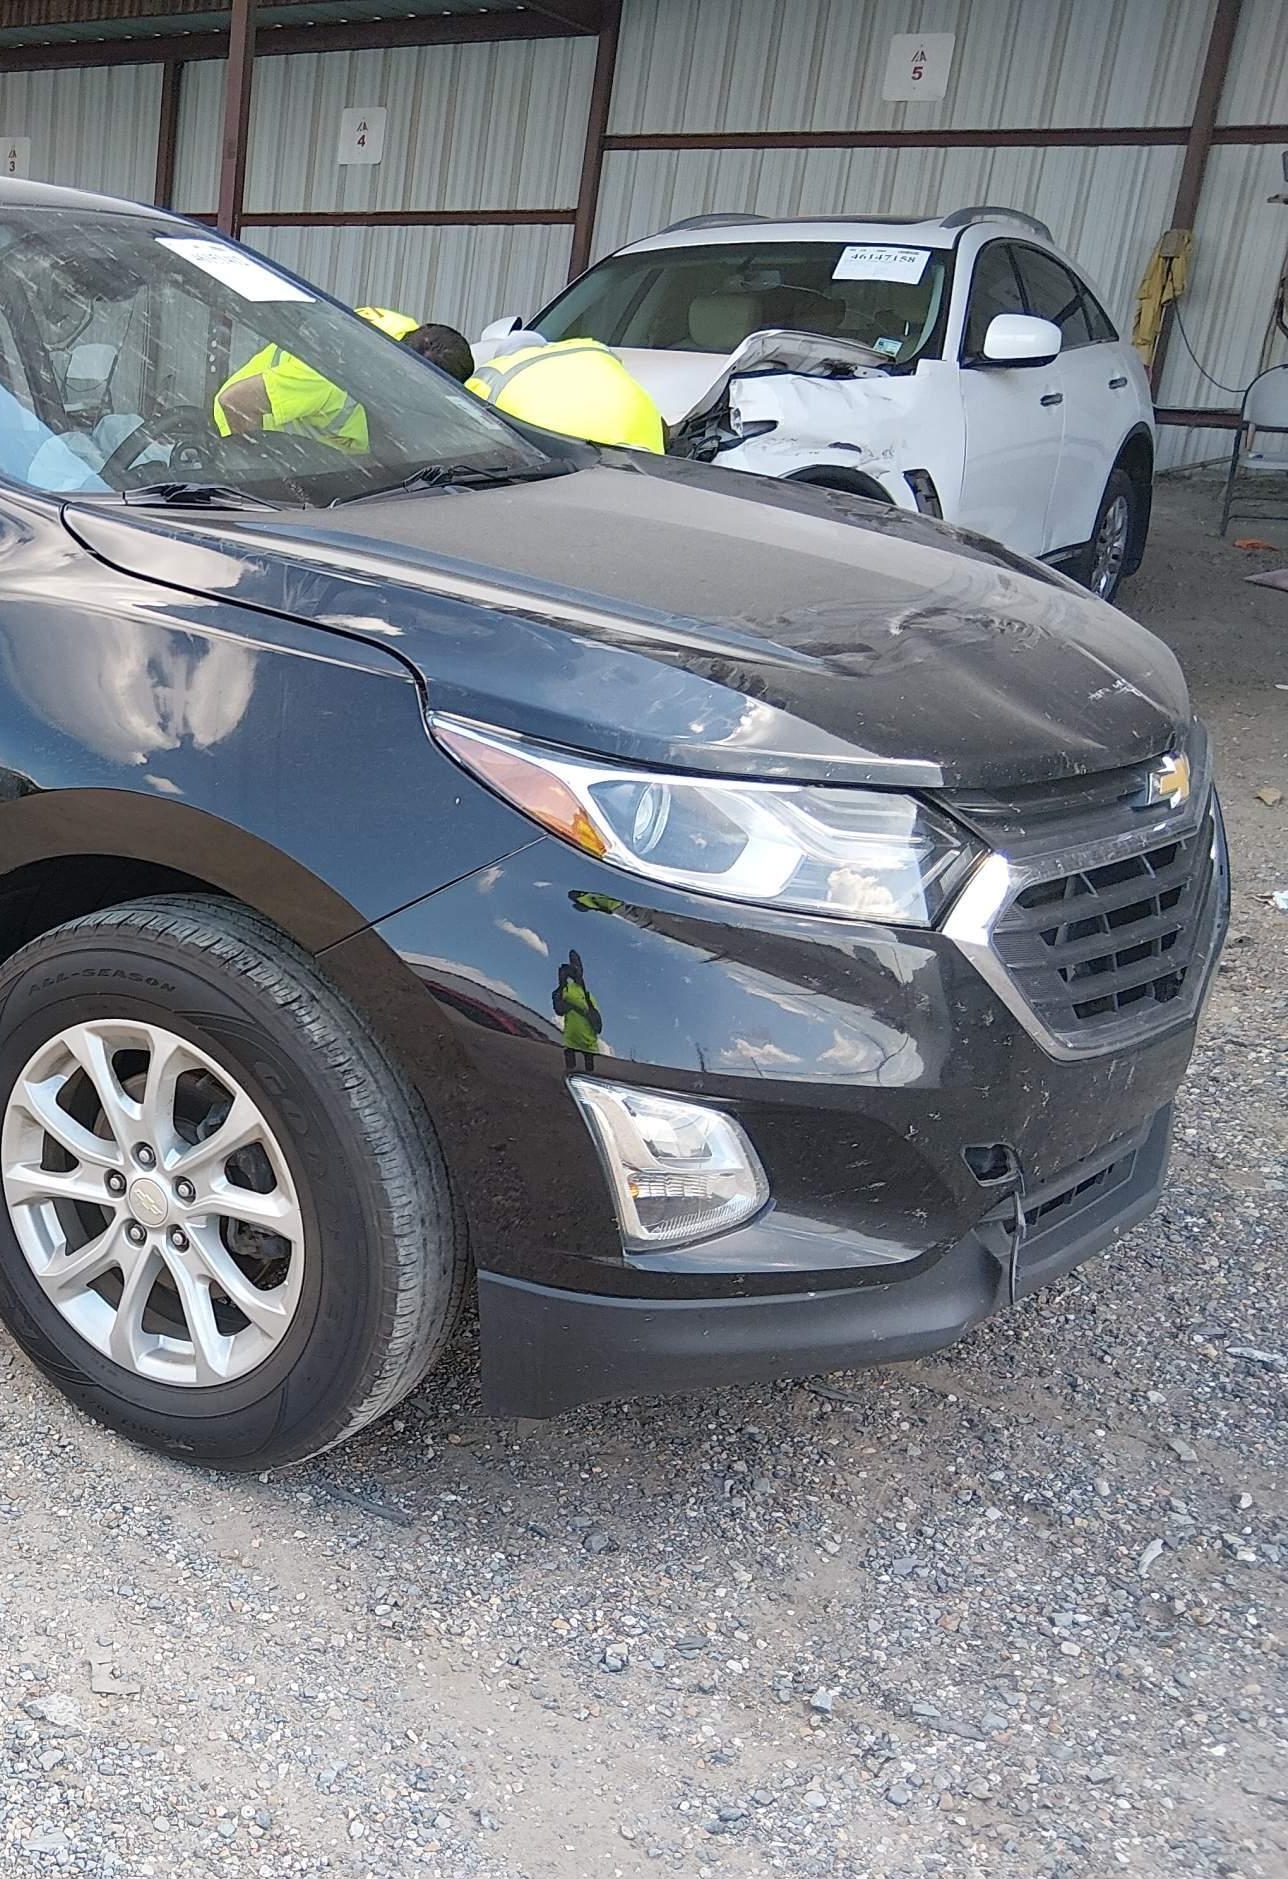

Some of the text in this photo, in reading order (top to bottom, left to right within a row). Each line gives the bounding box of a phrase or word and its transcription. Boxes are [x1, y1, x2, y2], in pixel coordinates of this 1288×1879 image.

[911, 66, 924, 81] 5
[357, 134, 366, 148] 4
[9, 160, 16, 172] 3
[27, 967, 177, 997] ALL-SEASON
